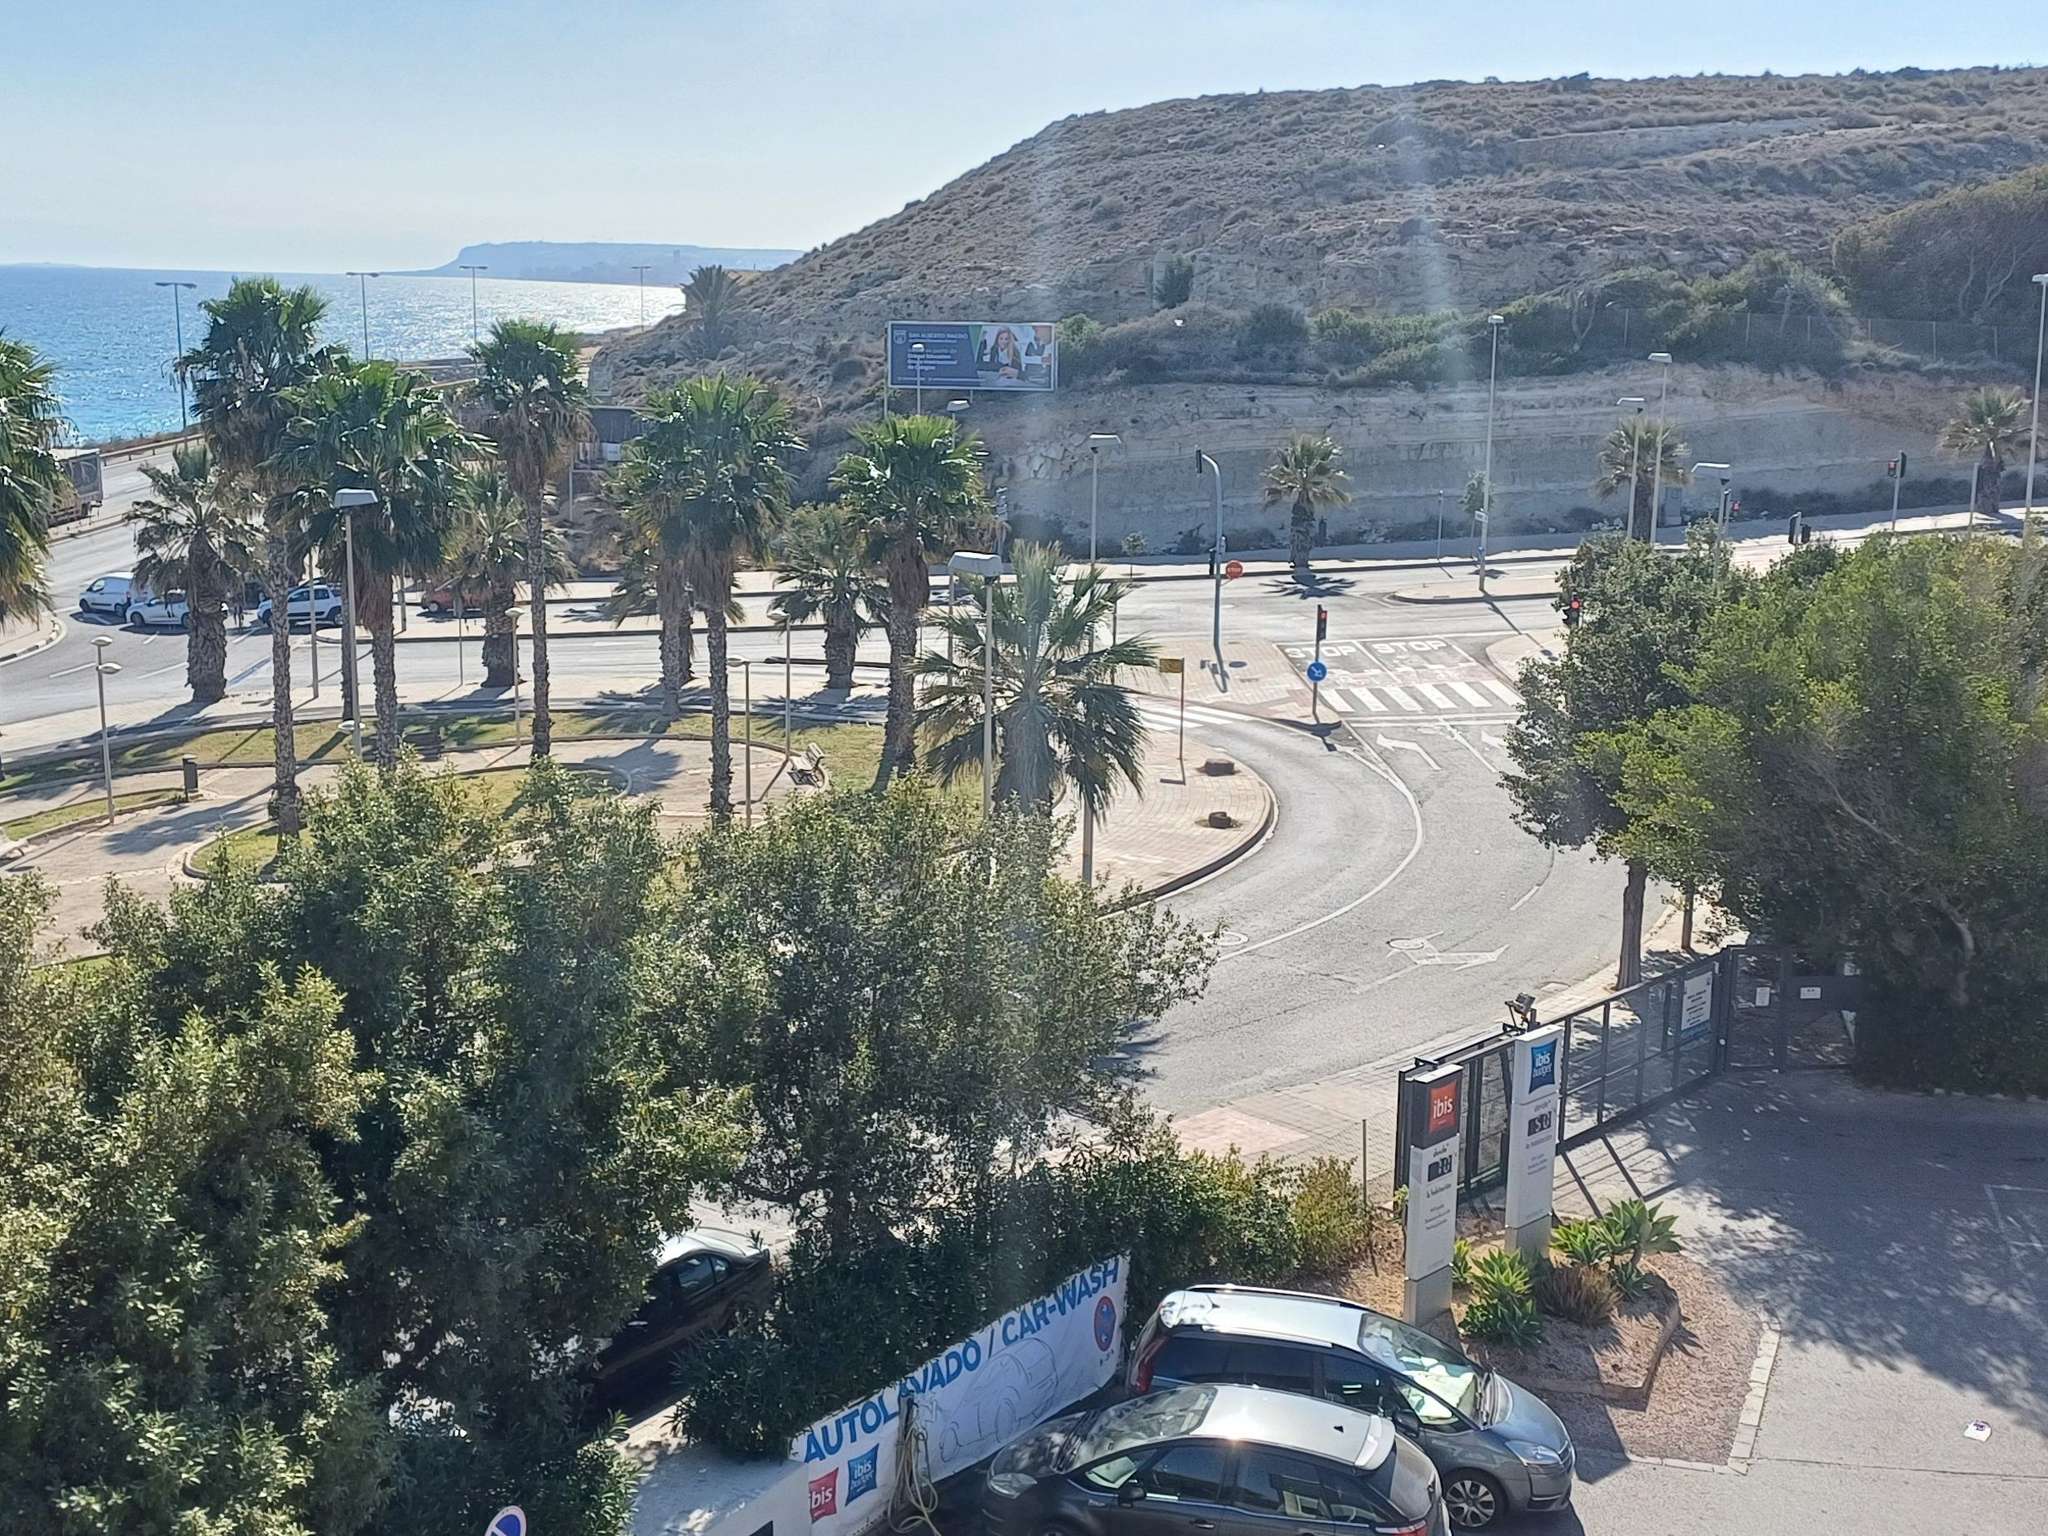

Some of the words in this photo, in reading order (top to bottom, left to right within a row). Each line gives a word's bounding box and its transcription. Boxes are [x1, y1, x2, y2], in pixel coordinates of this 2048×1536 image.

[1285, 645, 1357, 658] STOP
[1372, 639, 1448, 653] STOP
[1535, 1052, 1551, 1068] ibis
[1433, 1096, 1453, 1119] ibis
[804, 1340, 981, 1464] AUTOLAVADO
[1002, 1258, 1120, 1346] CAR-WASH
[854, 1459, 872, 1479] ibis
